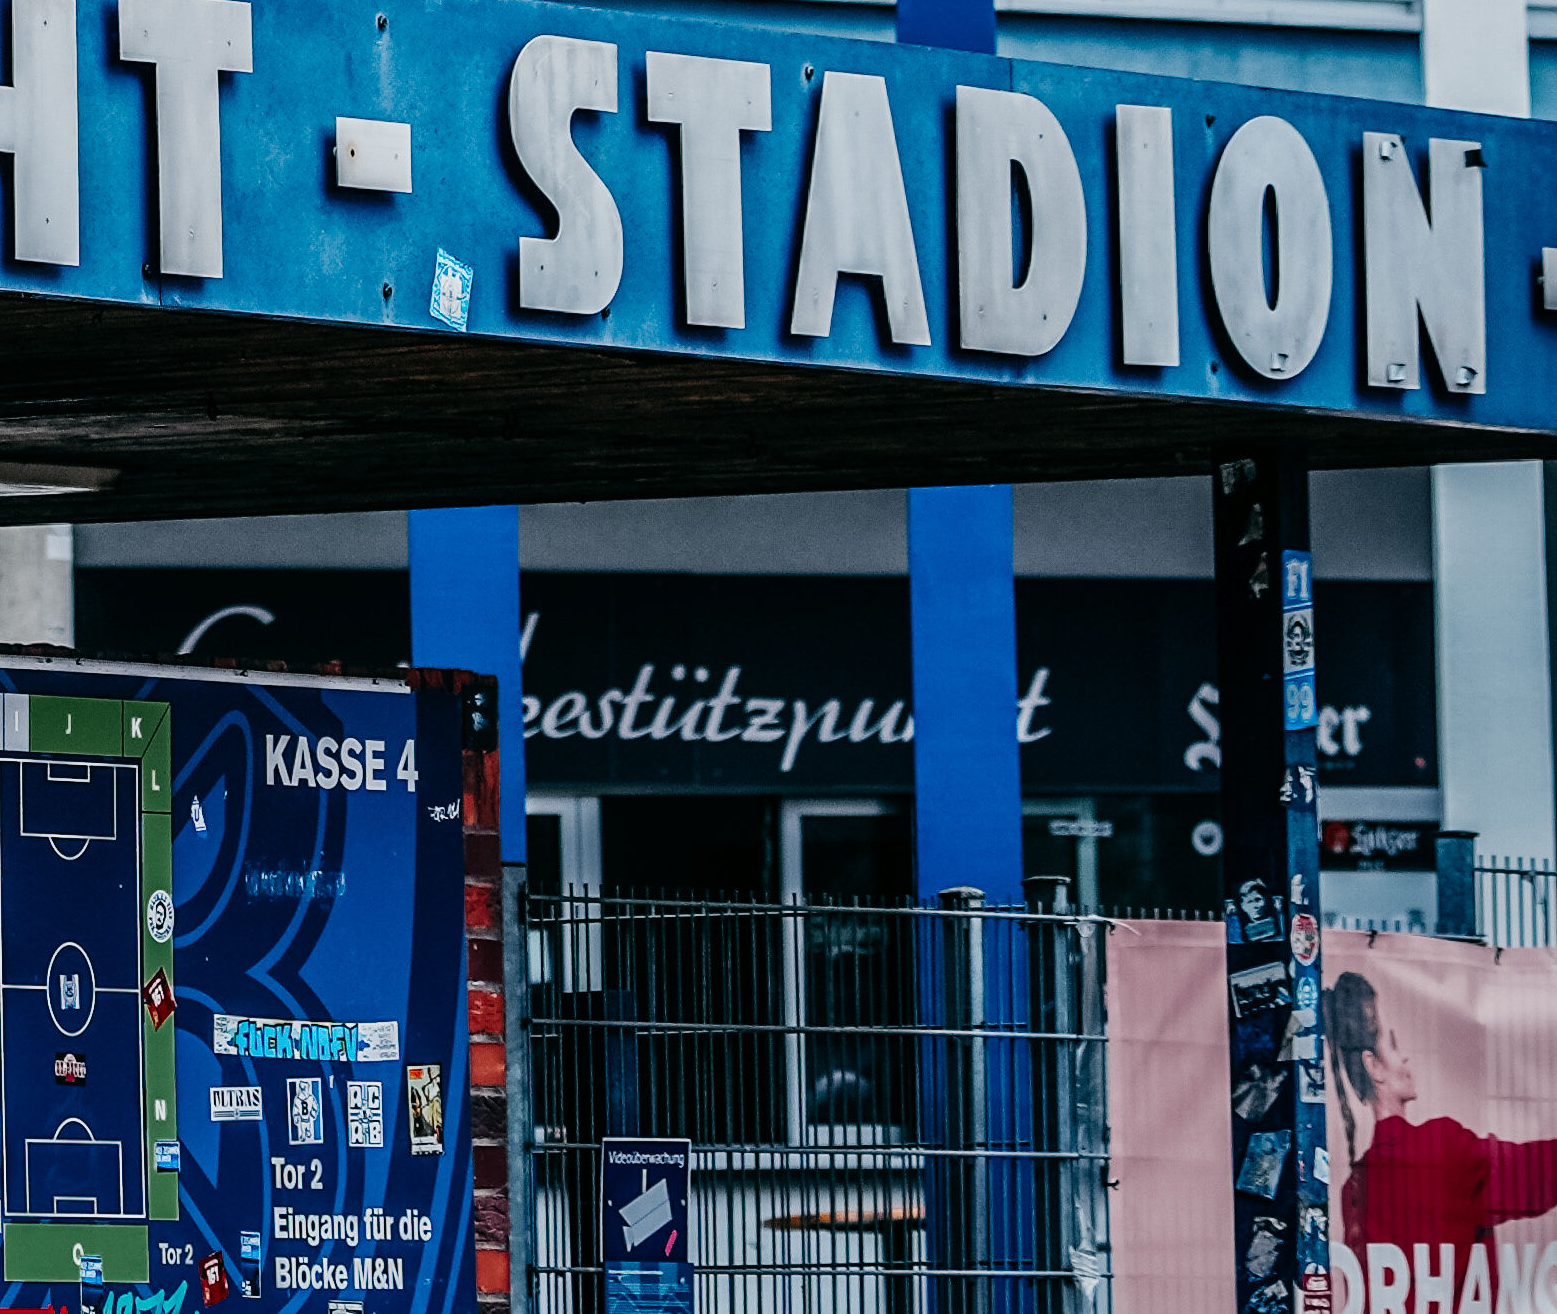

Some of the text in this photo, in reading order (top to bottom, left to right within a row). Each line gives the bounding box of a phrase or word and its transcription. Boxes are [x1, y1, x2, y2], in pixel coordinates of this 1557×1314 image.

[509, 33, 1487, 395] STADION
[65, 713, 72, 734] J
[131, 717, 143, 739] K
[265, 734, 419, 792] KASSE 4
[151, 769, 161, 791] L
[236, 1019, 294, 1059] FUCK
[154, 1099, 167, 1122] N
[271, 1157, 323, 1190] Tor 2
[609, 1151, 684, 1168] Videoüberwachung
[273, 1206, 359, 1247] Eingang
[363, 1207, 394, 1241] für
[399, 1209, 432, 1242] die
[158, 1242, 194, 1265] Tor 2
[275, 1256, 404, 1290] Blöcke M&N
